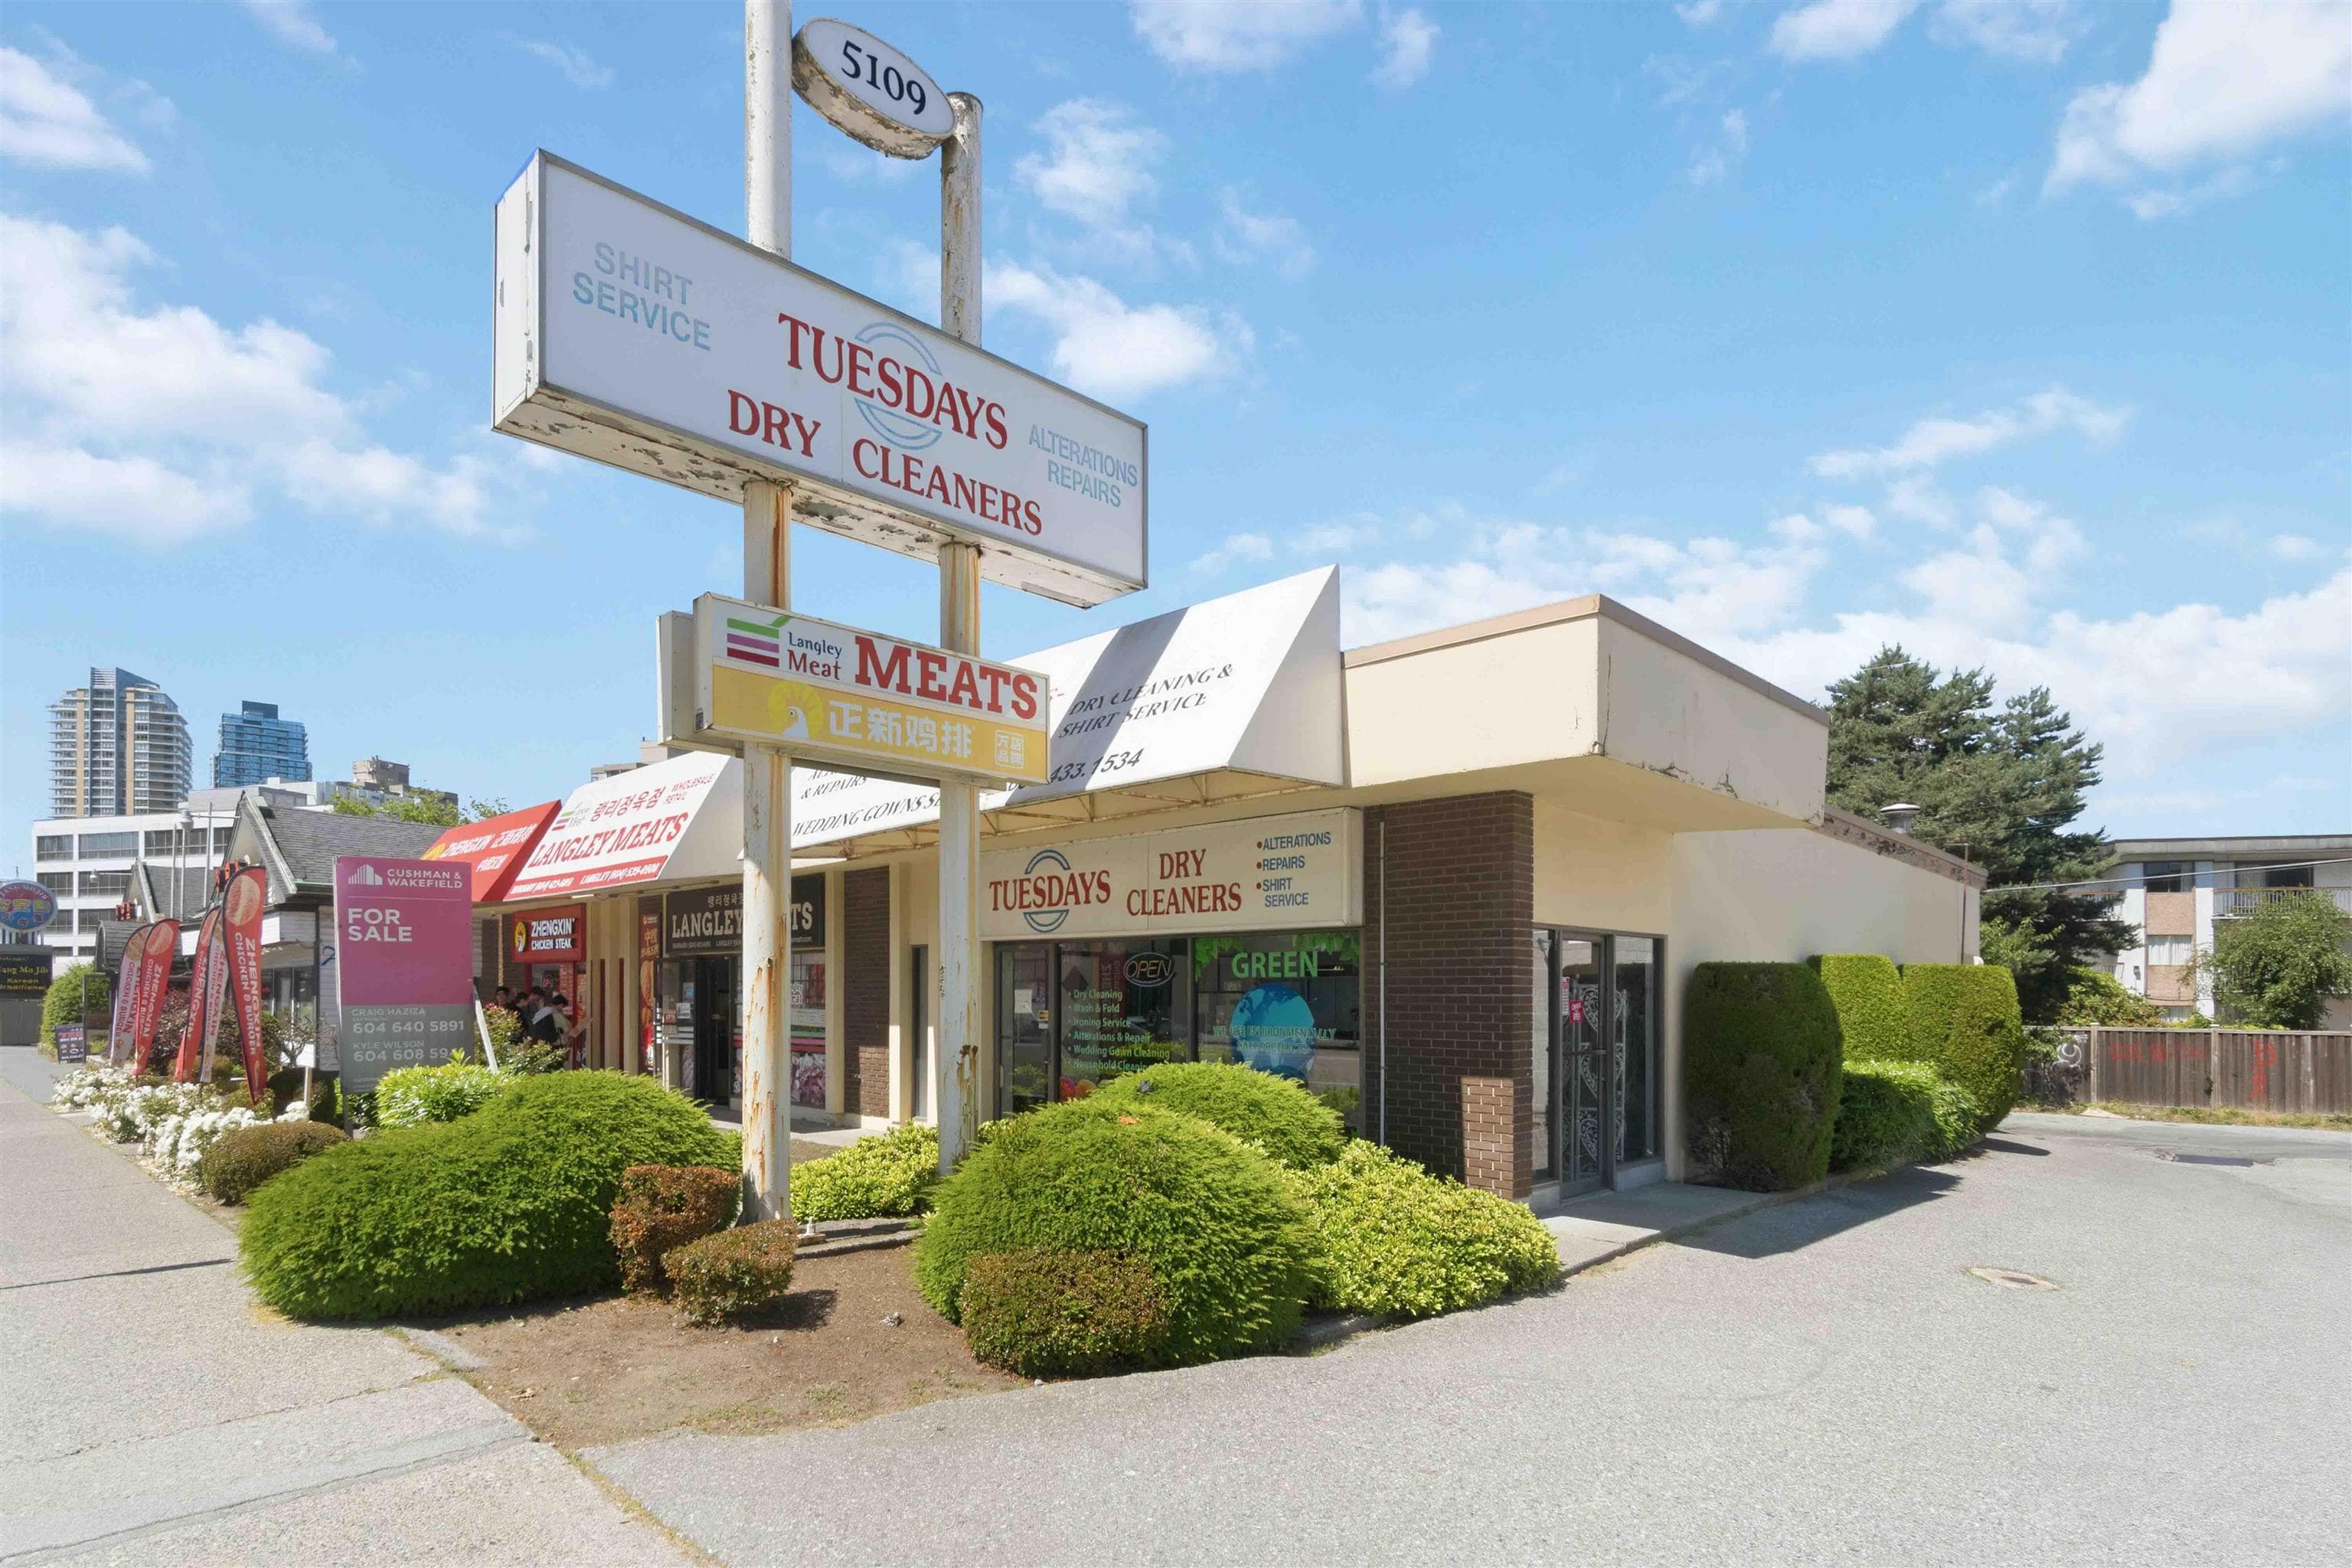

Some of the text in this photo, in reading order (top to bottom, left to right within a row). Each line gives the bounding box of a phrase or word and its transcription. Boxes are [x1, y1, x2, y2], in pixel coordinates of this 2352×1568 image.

[841, 40, 926, 116] 5109
[594, 241, 693, 305] SHIRT
[572, 271, 711, 352] SERVICE
[778, 312, 1008, 450] TUESDAYS
[727, 389, 1043, 536] DRY CLEANERS
[1028, 424, 1138, 488] ALTERATIONS
[1047, 460, 1121, 508] REPAIRS
[788, 632, 843, 659] Langley
[787, 648, 841, 681] Meat
[854, 635, 1038, 720] MEATS
[1068, 694, 1109, 716] DRY
[1110, 666, 1215, 705] CLEANING
[1217, 663, 1233, 678] &
[1058, 692, 1207, 739] SHIRT SERVICE
[828, 699, 974, 759] 正新鸡排
[812, 776, 868, 797] REPAIRS
[791, 808, 863, 837] WEDDING
[862, 794, 927, 822] GOWNS
[528, 829, 616, 869] LANGLEY
[612, 811, 690, 853] MEATS
[1263, 831, 1331, 851] ALTERATIONS
[387, 868, 462, 880] CUSHMAN &
[1158, 848, 1207, 880] DRY
[1262, 855, 1305, 871] REPAIRS
[387, 879, 463, 889] WAKEFIELD
[988, 869, 1111, 911] TUESDAYS
[1262, 877, 1293, 892] SHIRT
[1126, 882, 1242, 917] CLEANERS
[1264, 892, 1309, 908] SERVICE
[348, 907, 400, 925] FOR
[531, 918, 573, 937] ZHENGXIN
[671, 908, 743, 939] LANGLEY
[348, 925, 413, 942] SALE
[531, 938, 573, 950] CHICKEN STEAK
[234, 931, 250, 991] CHICKEN
[1125, 959, 1172, 978] OPEN
[1231, 951, 1318, 978] GREEN
[244, 936, 263, 1048] ZHENGXIN
[1073, 988, 1123, 1001] Dry Cleaning
[351, 1007, 426, 1017] CRAIG HAZIZA
[1102, 1003, 1120, 1013] Fold
[353, 1020, 465, 1034] 604 640 5891
[1073, 1017, 1132, 1028] Ironing Service
[353, 1040, 424, 1050] KYLE WILSON
[1073, 1031, 1116, 1041] Alterations
[1116, 1032, 1123, 1041] &
[354, 1047, 453, 1062] 604 608 59
[1073, 1045, 1170, 1060] Wedding Gown Cleaning
[1073, 1059, 1148, 1070] Household Cleanin
